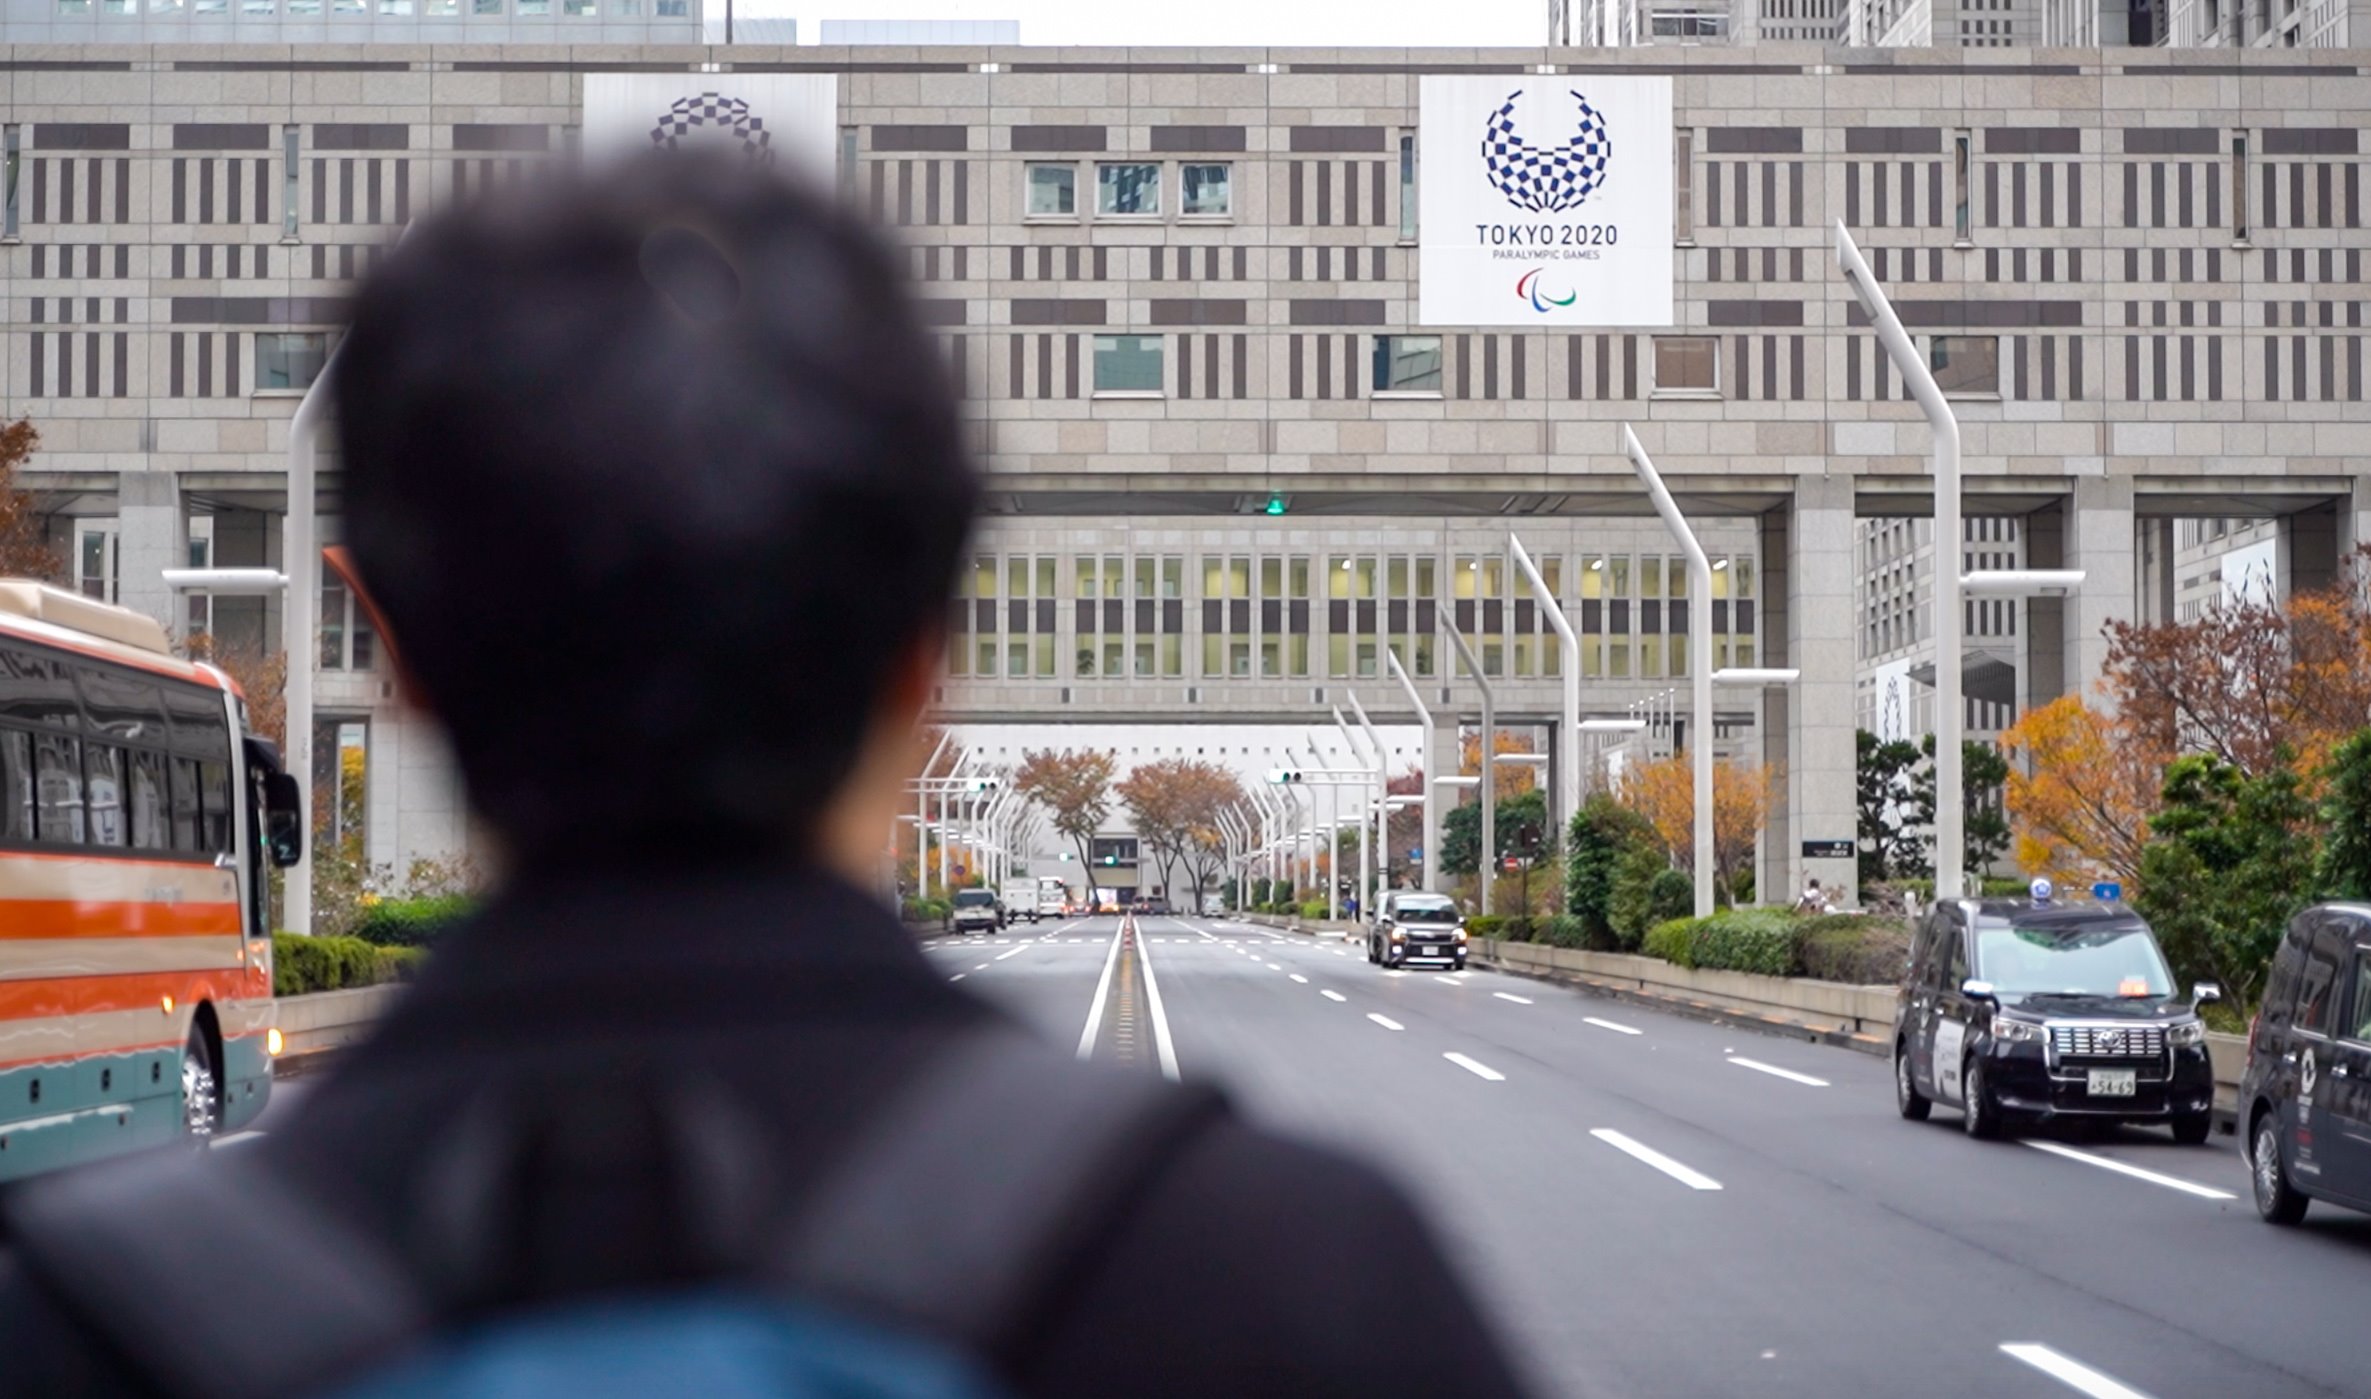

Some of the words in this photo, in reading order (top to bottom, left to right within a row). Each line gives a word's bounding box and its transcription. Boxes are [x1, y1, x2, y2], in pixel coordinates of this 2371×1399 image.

[1476, 224, 1553, 245] TOKYO
[1561, 224, 1617, 245] 2020
[1492, 249, 1560, 260] PARALYMPIC
[1563, 249, 1601, 260] GAMES
